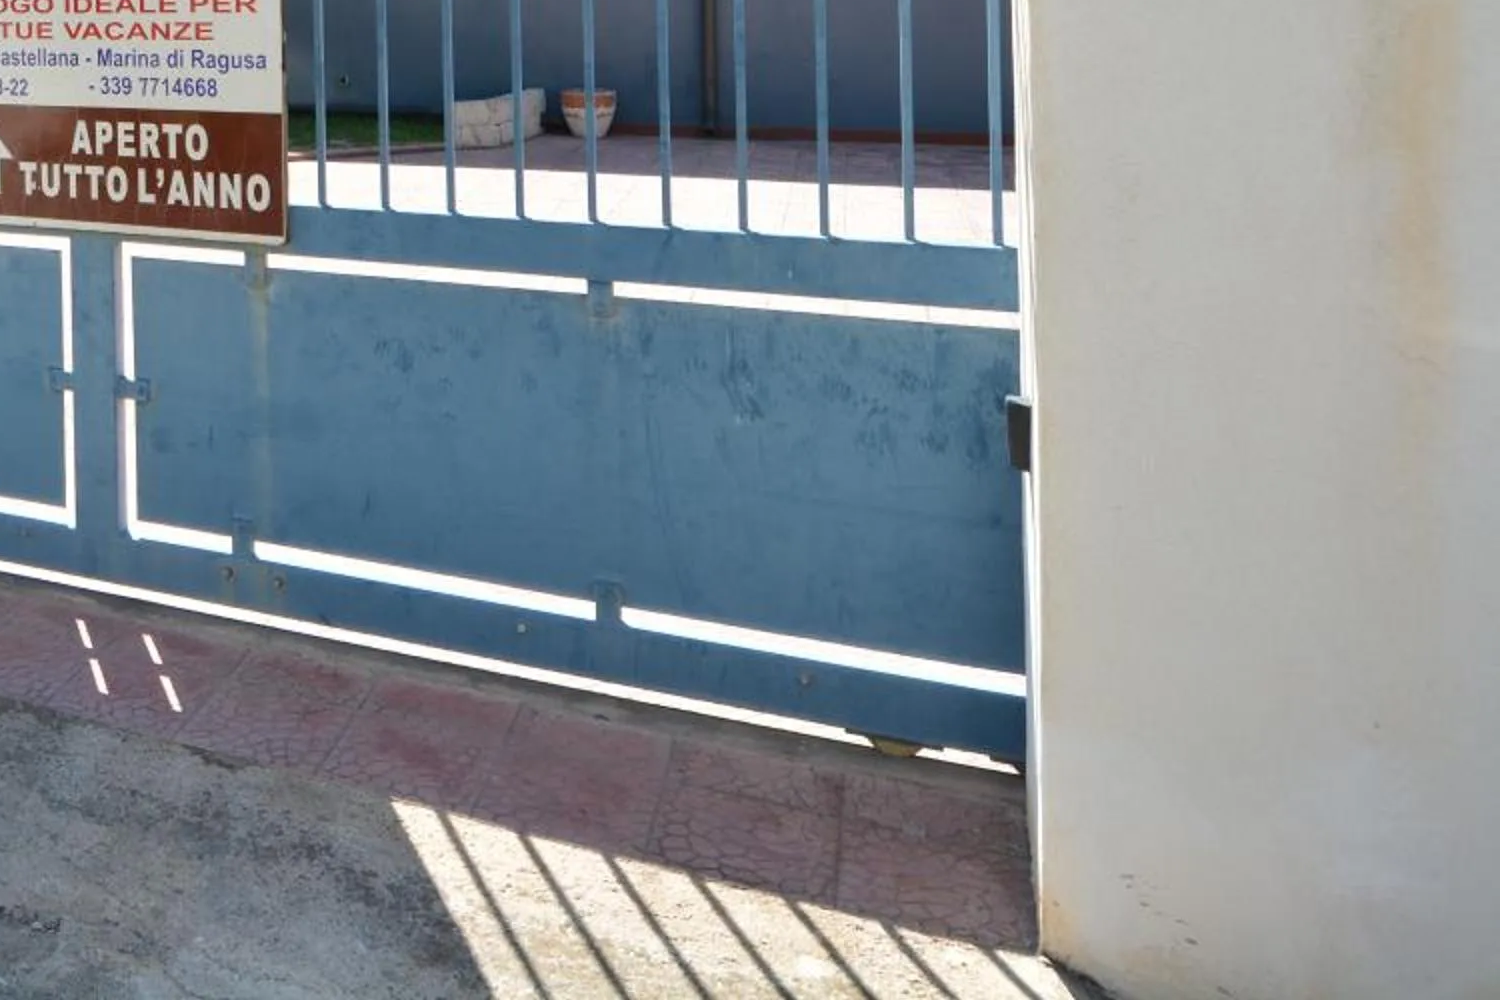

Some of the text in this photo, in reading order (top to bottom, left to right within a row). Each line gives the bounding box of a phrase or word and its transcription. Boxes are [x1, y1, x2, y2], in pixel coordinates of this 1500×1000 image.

[64, 21, 215, 41] VACANZE
[97, 48, 160, 68] Marina
[167, 48, 184, 69] di
[191, 49, 267, 75] Ragusa
[100, 76, 133, 96] 339
[138, 76, 218, 97] 7714668
[71, 119, 209, 161] APERTO
[19, 161, 271, 213] TUTTO L'ANNO
